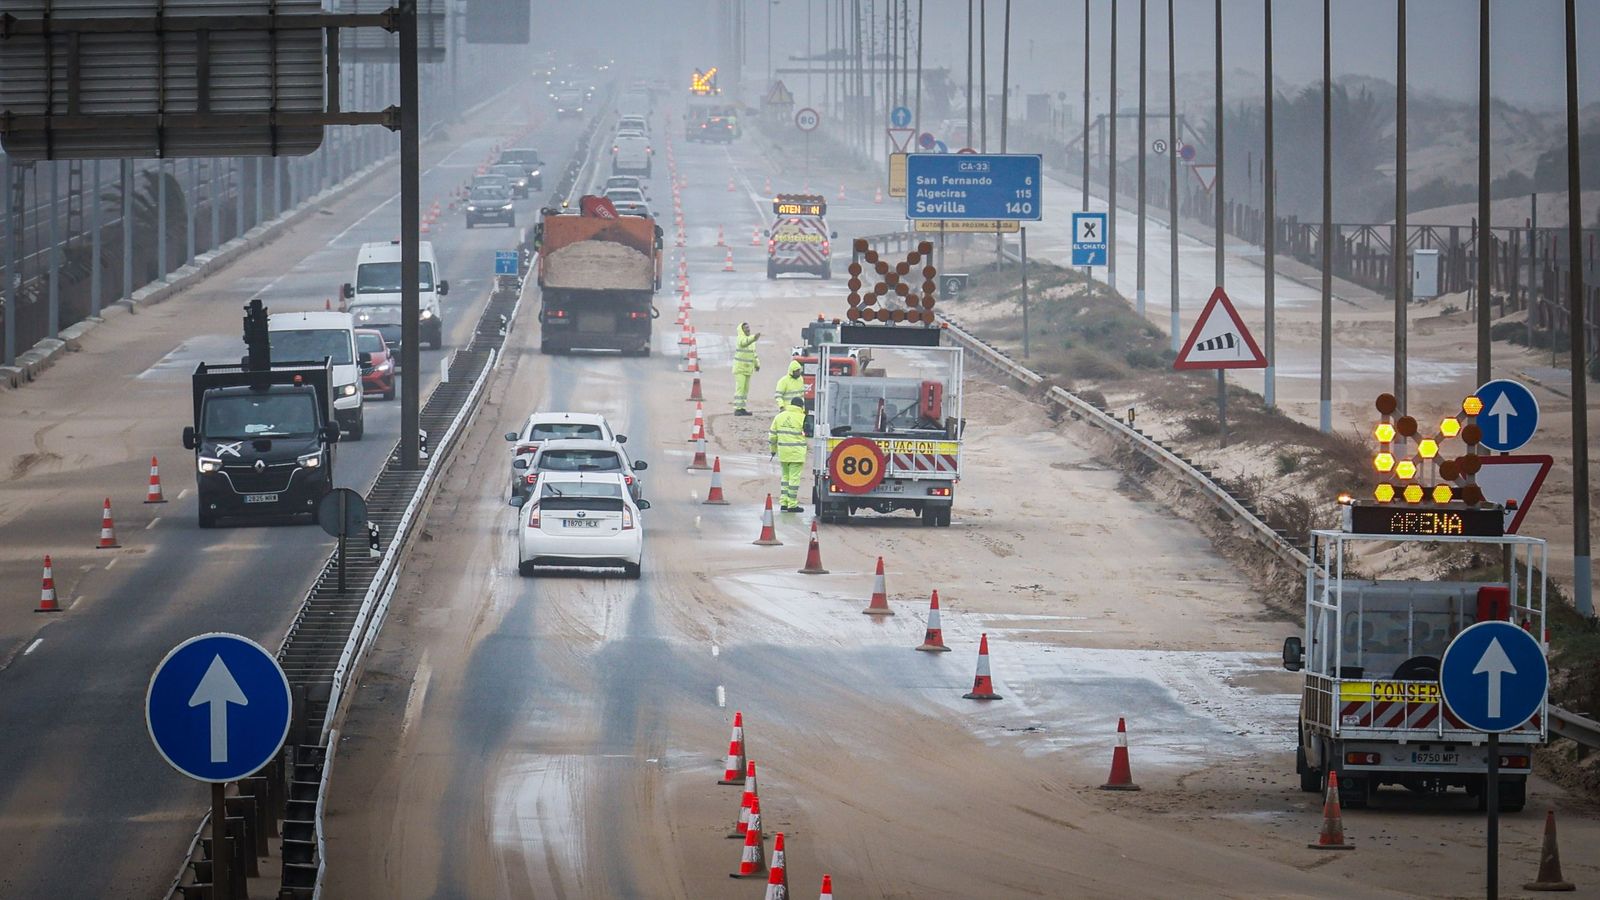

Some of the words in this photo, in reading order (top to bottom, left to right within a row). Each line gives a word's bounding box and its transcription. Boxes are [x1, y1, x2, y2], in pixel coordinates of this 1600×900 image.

[801, 116, 814, 125] 80
[960, 162, 988, 170] CA-33
[916, 175, 937, 185] San
[942, 175, 992, 185] Fernando
[1025, 176, 1032, 186] 6
[916, 188, 967, 198] Algeciras
[1016, 189, 1032, 198] 115
[916, 201, 966, 213] Sevilla
[1006, 202, 1032, 214] 140
[842, 456, 874, 476] 80
[567, 519, 582, 527] 1870
[1390, 512, 1463, 534] ARENA
[1417, 753, 1440, 762] 6750
[1443, 753, 1460, 762] MPT
